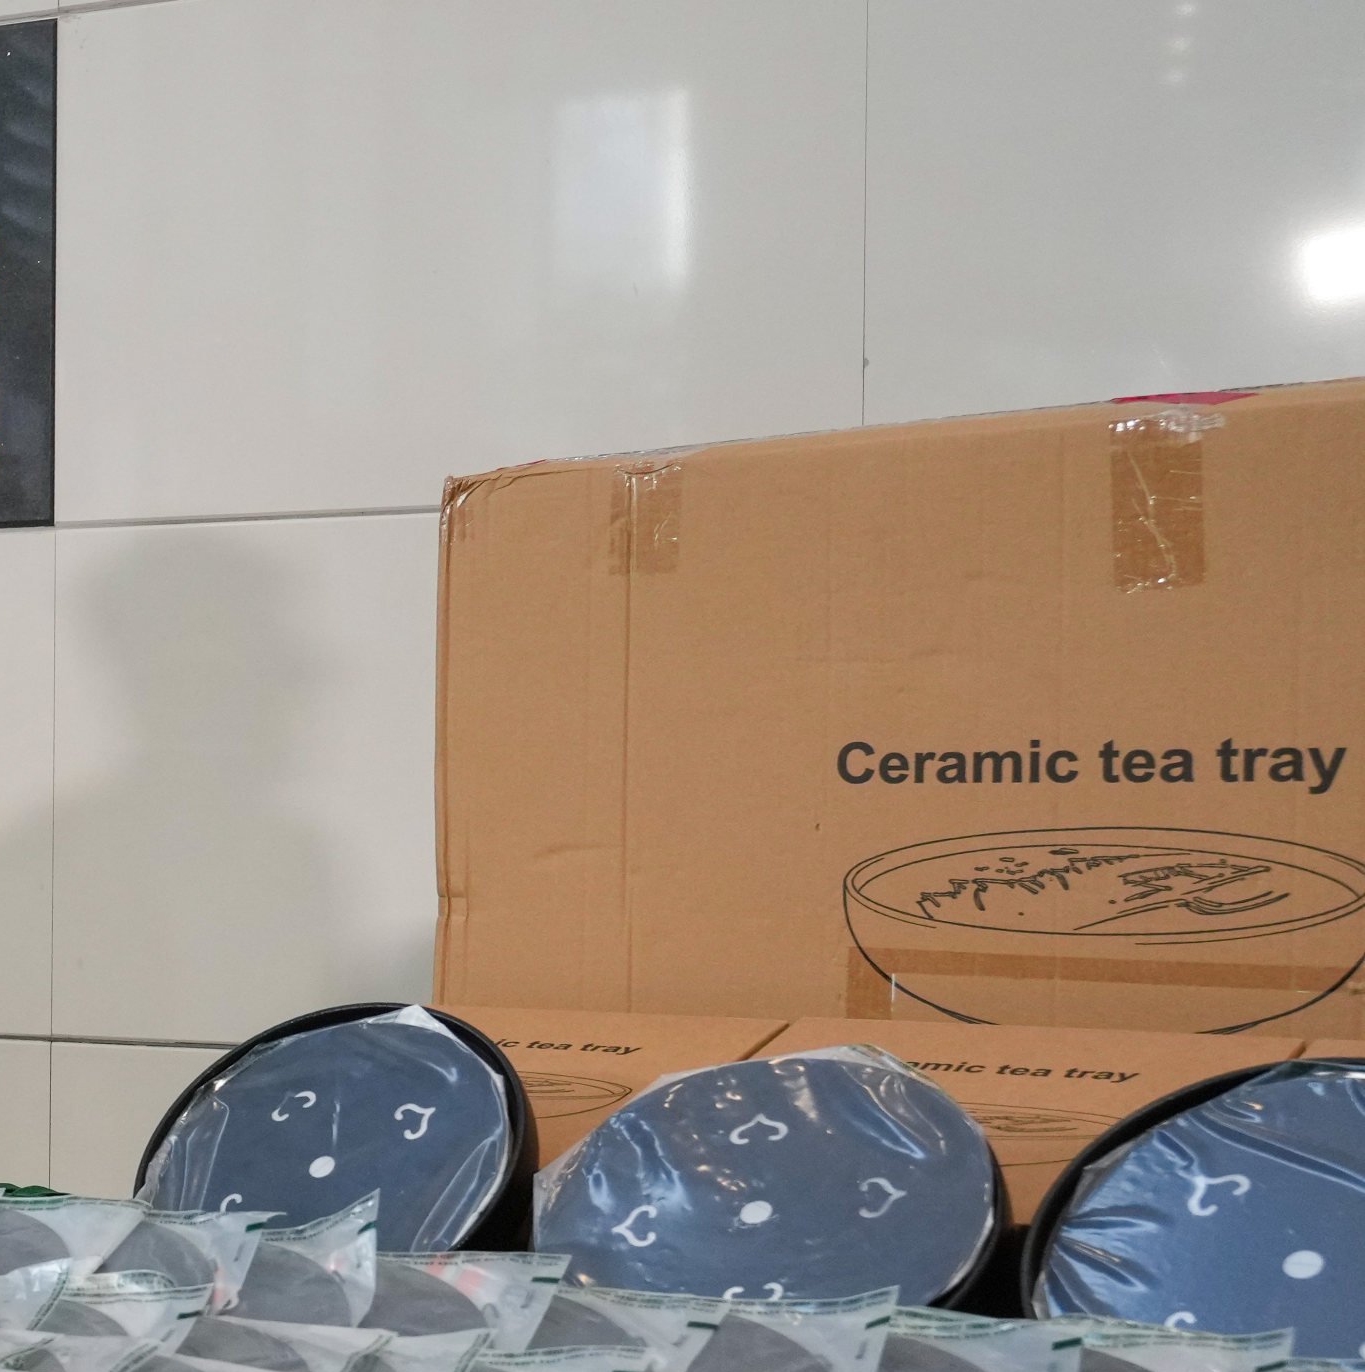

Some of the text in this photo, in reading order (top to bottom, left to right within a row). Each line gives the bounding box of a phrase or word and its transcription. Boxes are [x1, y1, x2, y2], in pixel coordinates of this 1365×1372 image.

[836, 737, 1348, 795] Ceramic tea tray
[526, 1040, 574, 1051] tea
[580, 1043, 643, 1056] tray
[905, 1061, 1141, 1084] amic tea tray
